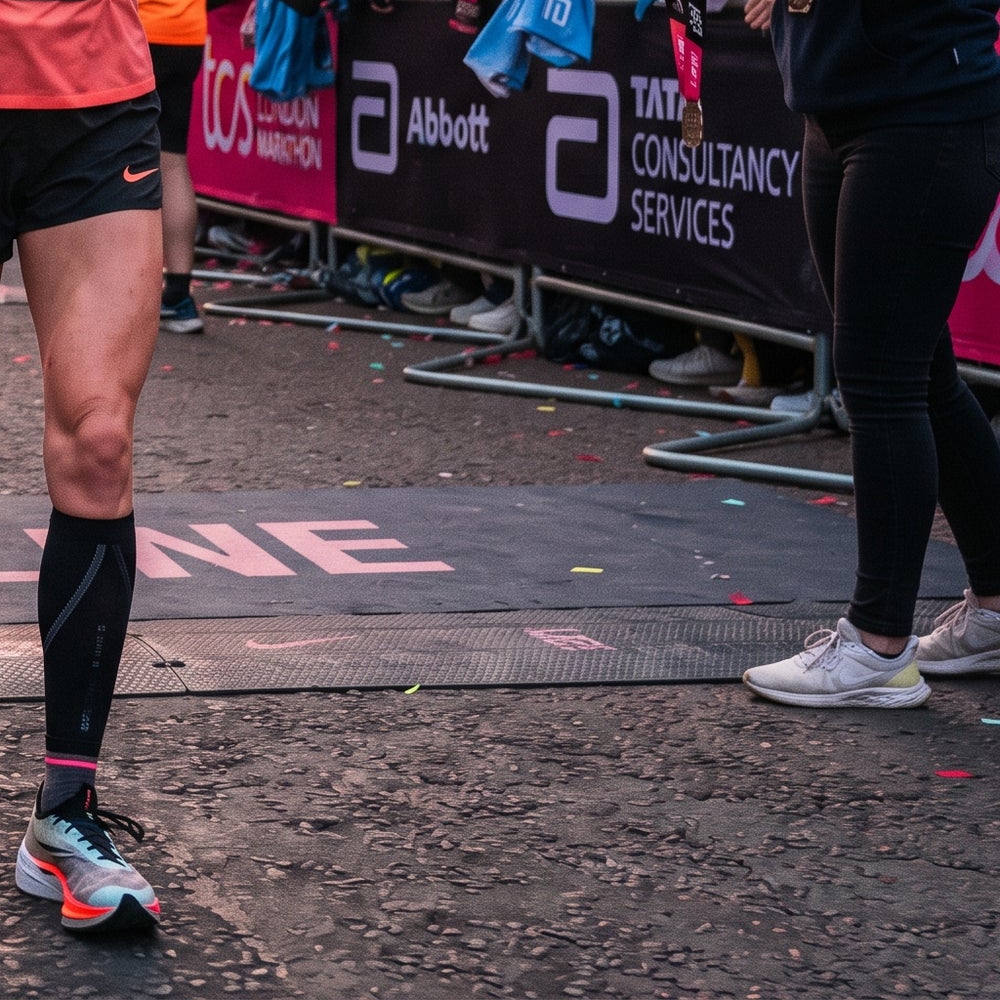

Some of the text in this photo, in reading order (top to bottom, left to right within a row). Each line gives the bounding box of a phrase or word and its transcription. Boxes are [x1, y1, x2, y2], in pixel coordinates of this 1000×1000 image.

[201, 35, 254, 157] tcs
[406, 97, 490, 154] Abbott
[631, 132, 800, 198] CONSULTANCY
[631, 188, 735, 250] SERVICES
